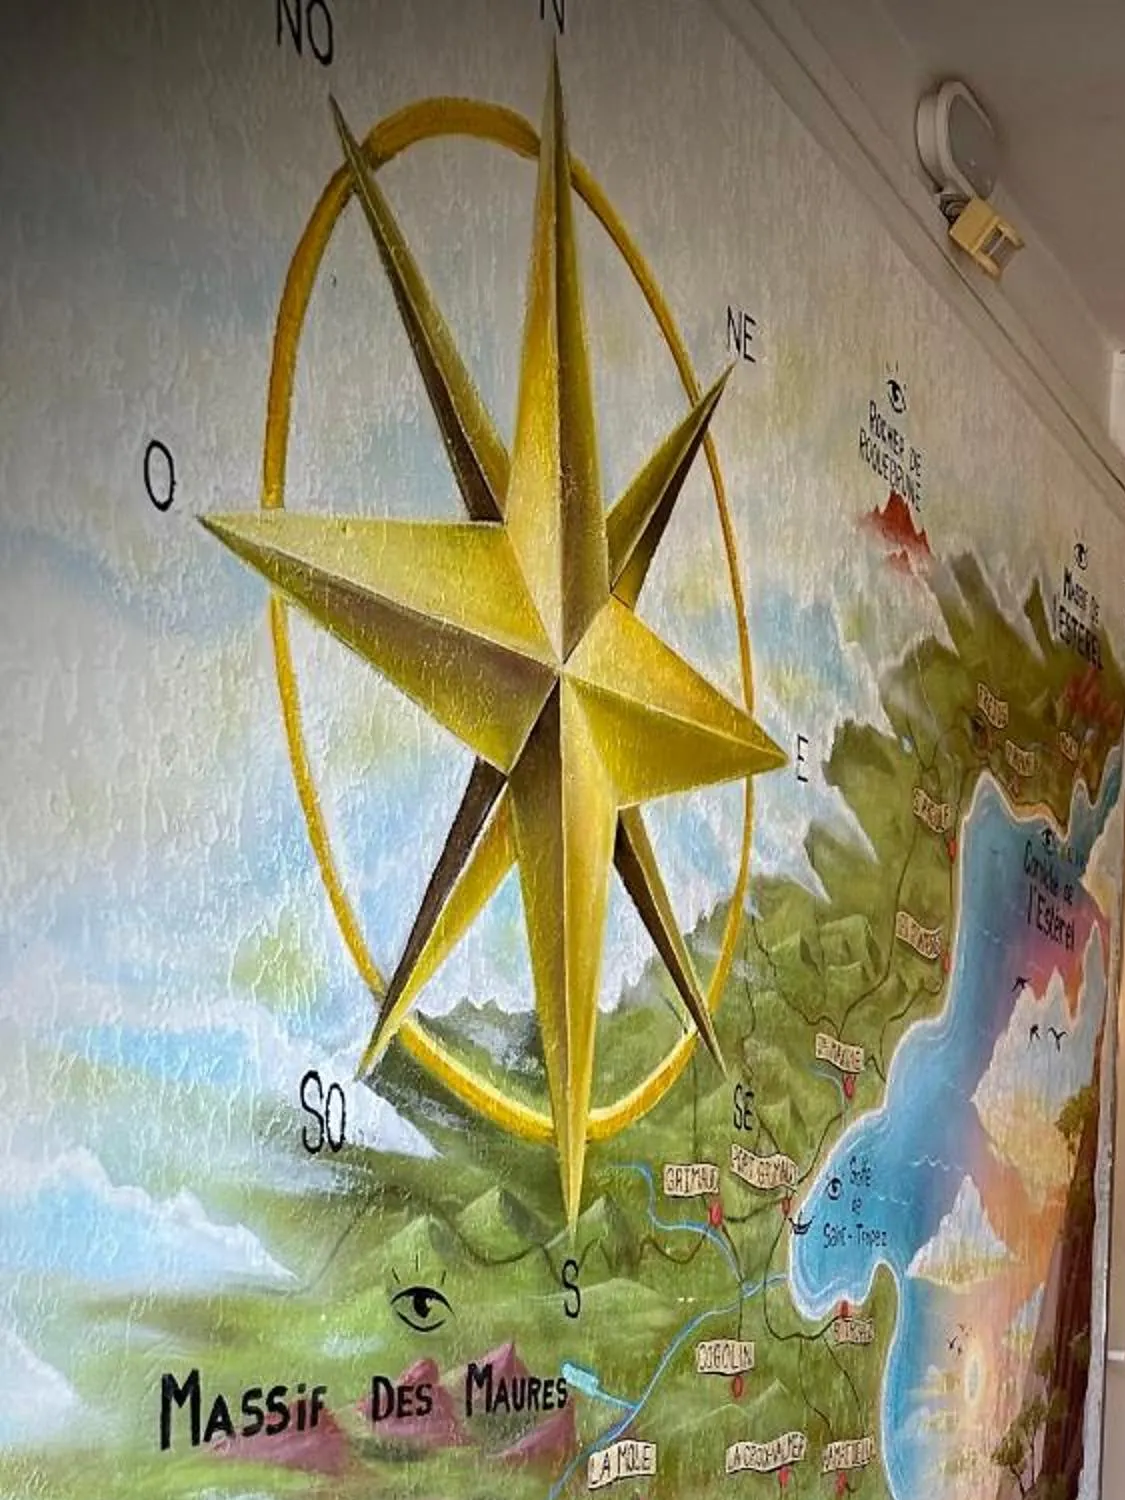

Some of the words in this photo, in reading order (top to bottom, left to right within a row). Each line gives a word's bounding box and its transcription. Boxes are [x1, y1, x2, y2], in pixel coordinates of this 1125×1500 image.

[277, 0, 333, 65] NO
[726, 306, 757, 363] NE
[143, 440, 175, 511] O
[797, 733, 808, 783] E
[299, 1070, 347, 1154] SO
[733, 1083, 754, 1131] SE
[561, 1259, 581, 1319] S
[371, 1375, 433, 1422] DES
[465, 1362, 569, 1417] MAURES
